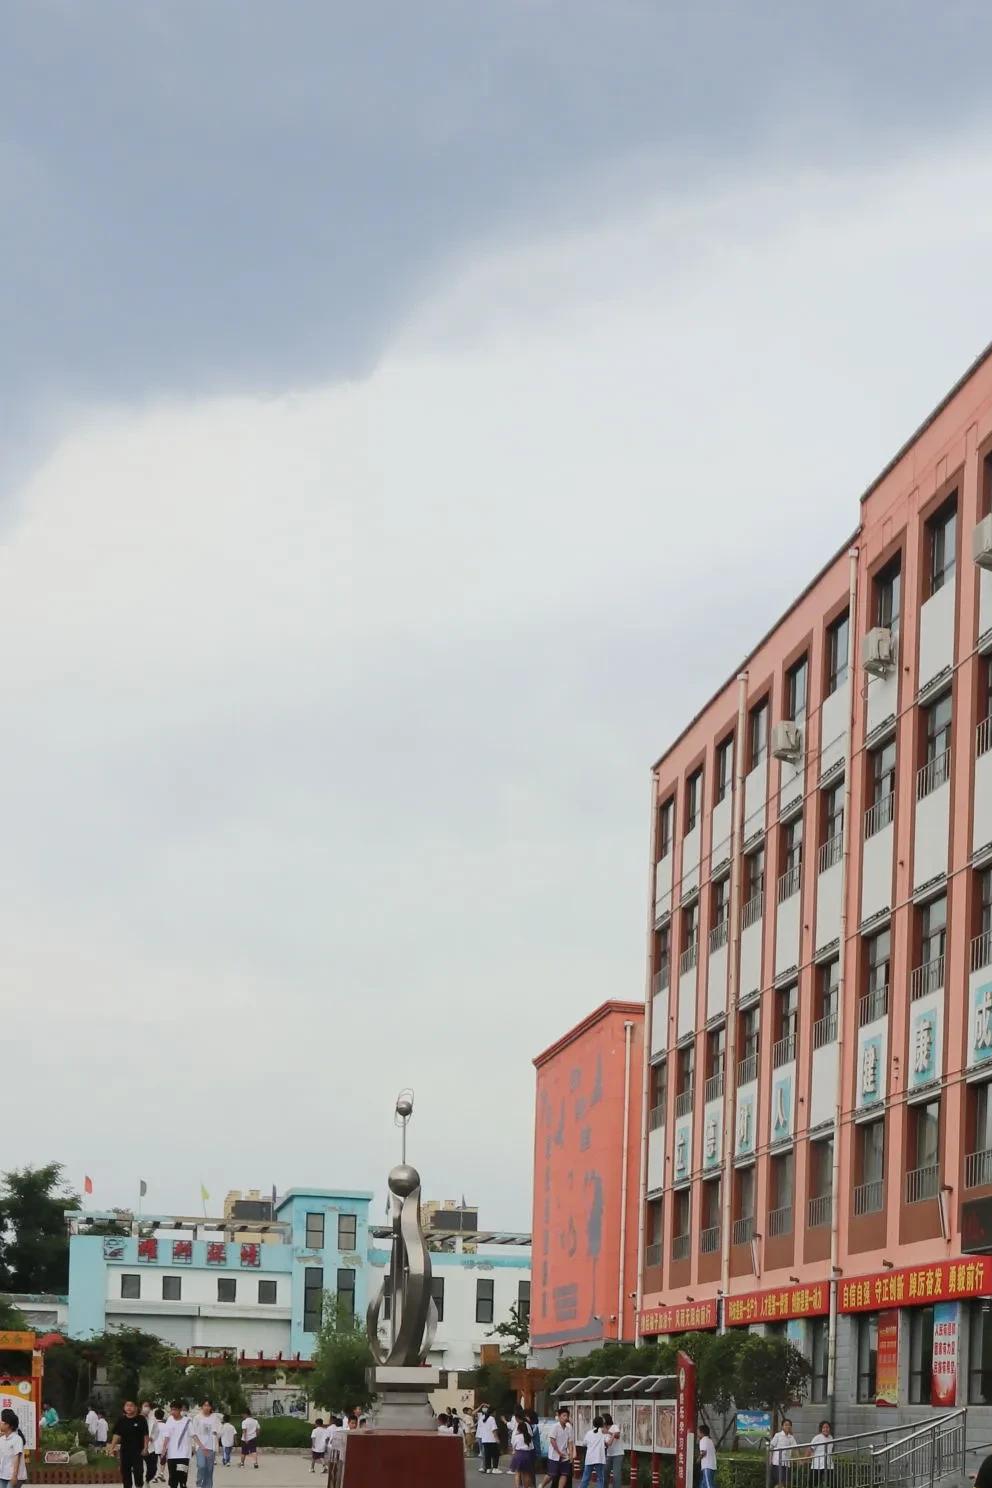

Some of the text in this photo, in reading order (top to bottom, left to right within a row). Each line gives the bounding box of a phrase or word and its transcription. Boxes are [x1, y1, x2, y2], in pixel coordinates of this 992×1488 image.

[843, 1262, 984, 1313] 自信自强 守正创新 踔厉奋发 勇毅前行
